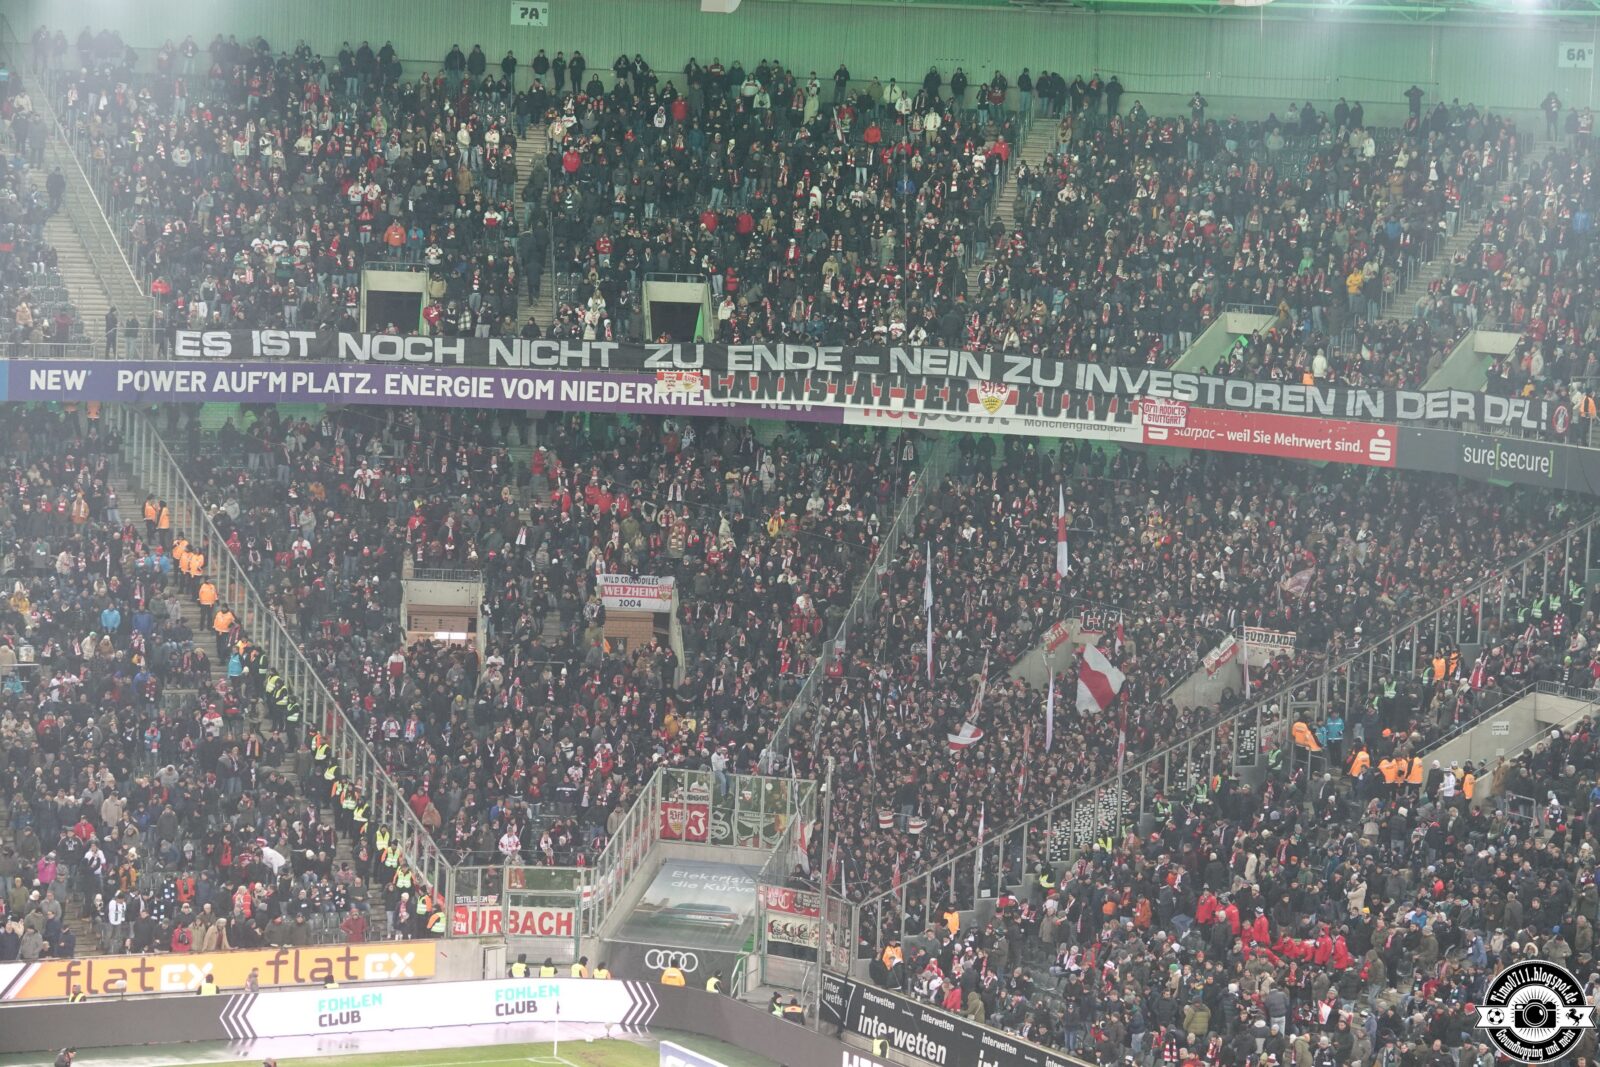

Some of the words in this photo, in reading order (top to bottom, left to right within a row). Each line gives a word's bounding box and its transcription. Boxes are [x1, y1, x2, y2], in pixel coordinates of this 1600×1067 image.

[520, 7, 539, 19] 7A
[1567, 48, 1585, 61] 6A
[117, 370, 207, 393] POWER
[292, 371, 378, 395] PLATZ.
[384, 373, 494, 399] ENERGIE
[501, 377, 554, 401] VOM
[175, 330, 232, 357] ES
[252, 330, 316, 357] IST
[338, 332, 465, 364] NOCH
[489, 338, 619, 368] NICHT
[644, 343, 704, 369] ZU
[727, 343, 843, 371] ENDE
[889, 347, 992, 380] NEIN
[1003, 356, 1064, 387] ZU
[1075, 362, 1336, 416] INVESTOREN
[1345, 389, 1384, 418] IN
[1396, 390, 1476, 420] DER
[1484, 394, 1547, 430] DFL!
[1147, 413, 1182, 425] STUTTGART
[1227, 429, 1250, 443] weil
[1253, 430, 1270, 444] Sie
[1274, 432, 1332, 451] Mehrwert
[1335, 438, 1363, 454] sind.
[603, 576, 619, 584] WILD
[603, 585, 658, 598] WELZHEIM
[619, 599, 642, 607] 2004
[671, 880, 699, 889] die
[495, 984, 559, 1002] FOHLEN
[825, 991, 848, 1008] wette
[863, 988, 896, 1010] interwetten
[319, 993, 382, 1012] FOHLEN
[495, 1000, 538, 1016] CLUB
[319, 1010, 361, 1027] CLUB
[921, 1010, 955, 1032] interwetten
[981, 1032, 1017, 1055] interwetten
